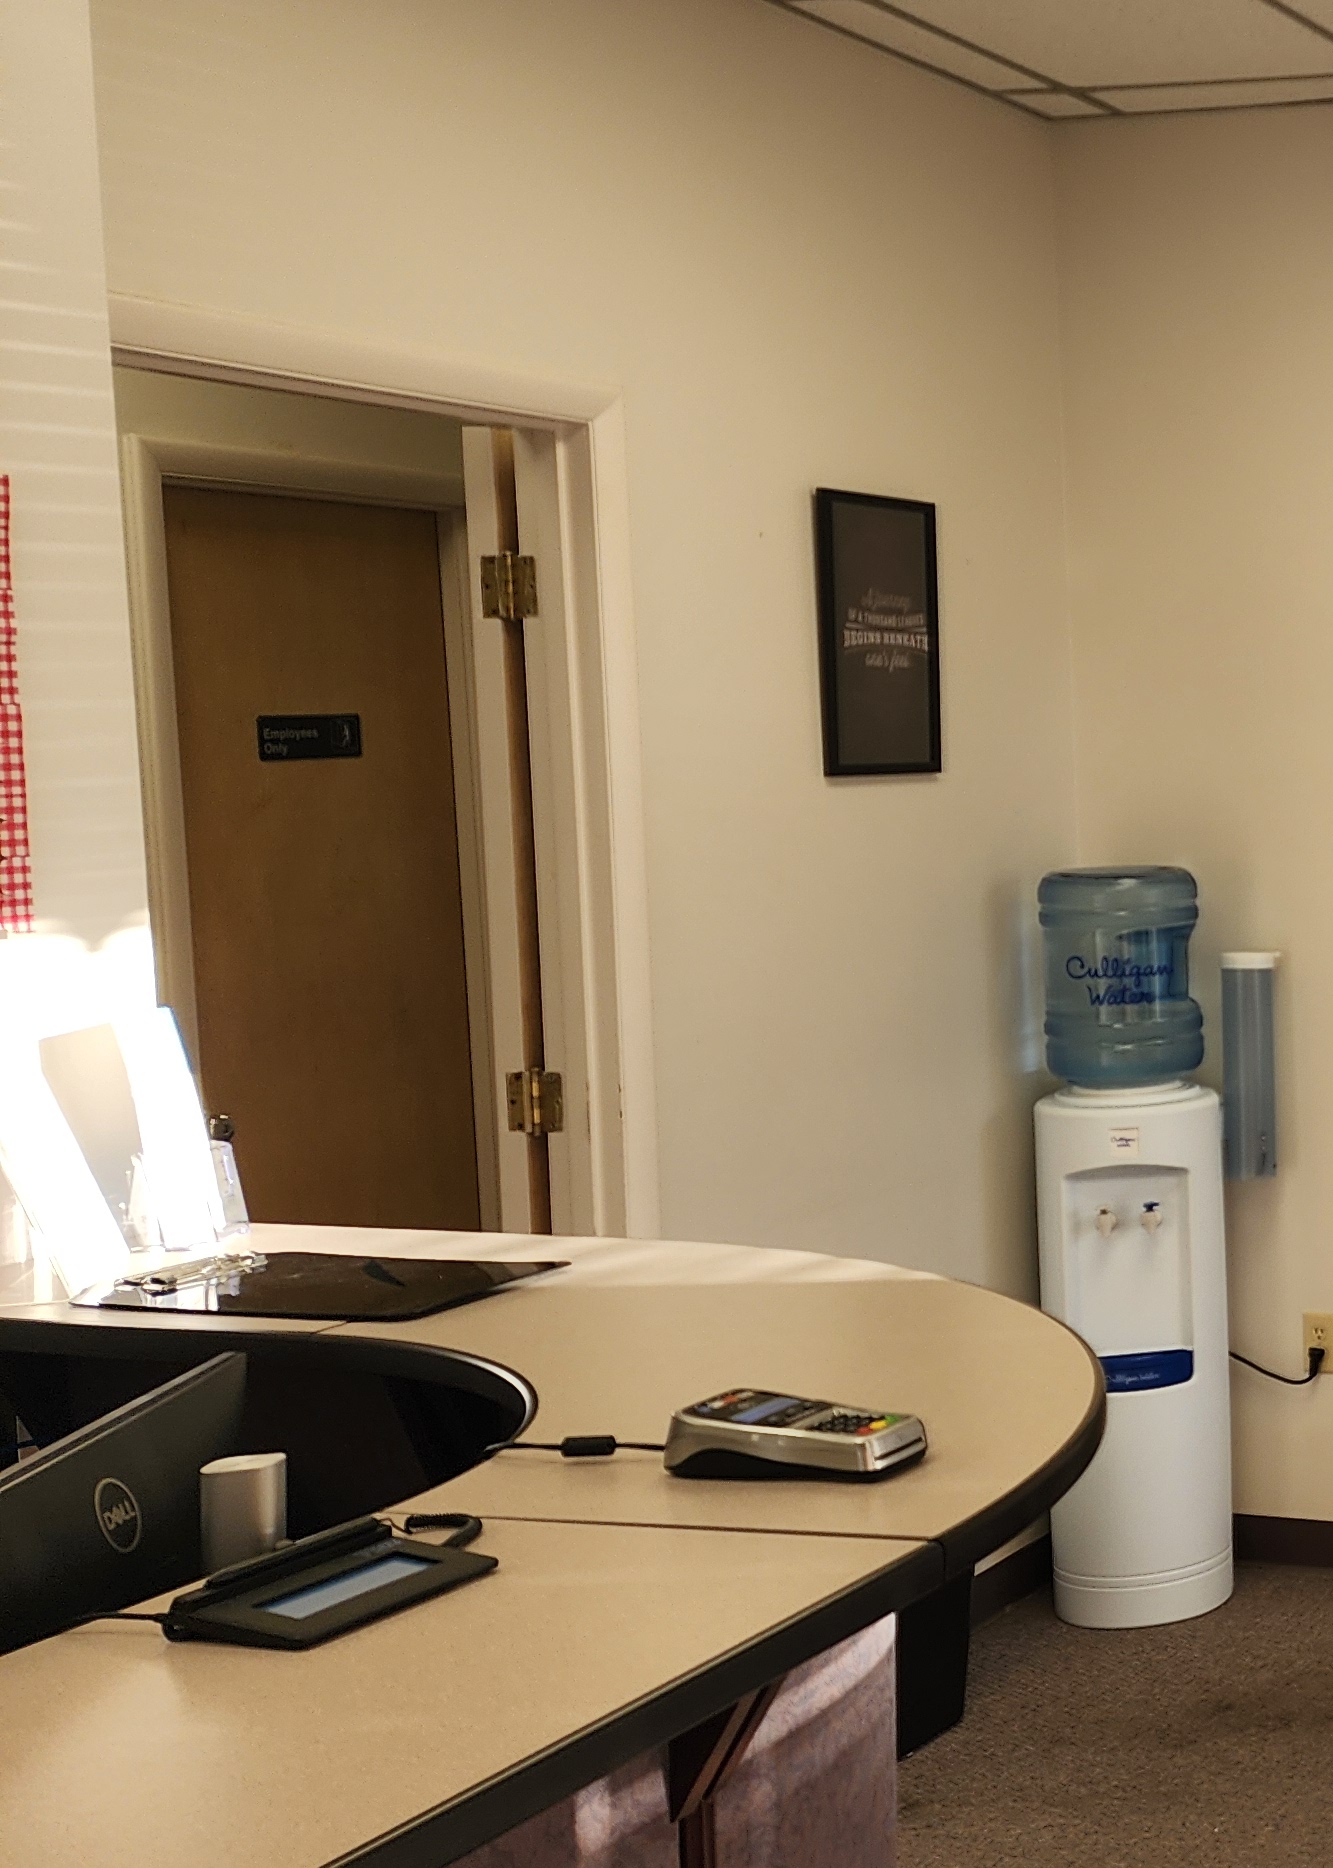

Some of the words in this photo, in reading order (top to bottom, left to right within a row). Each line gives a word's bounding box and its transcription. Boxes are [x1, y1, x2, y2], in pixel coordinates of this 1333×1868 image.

[843, 629, 881, 648] BEGINS
[263, 727, 318, 741] Employees
[264, 743, 288, 755] Only
[1066, 955, 1173, 989] Culligan
[1086, 984, 1155, 1006] Water
[103, 1499, 136, 1530] DELL
